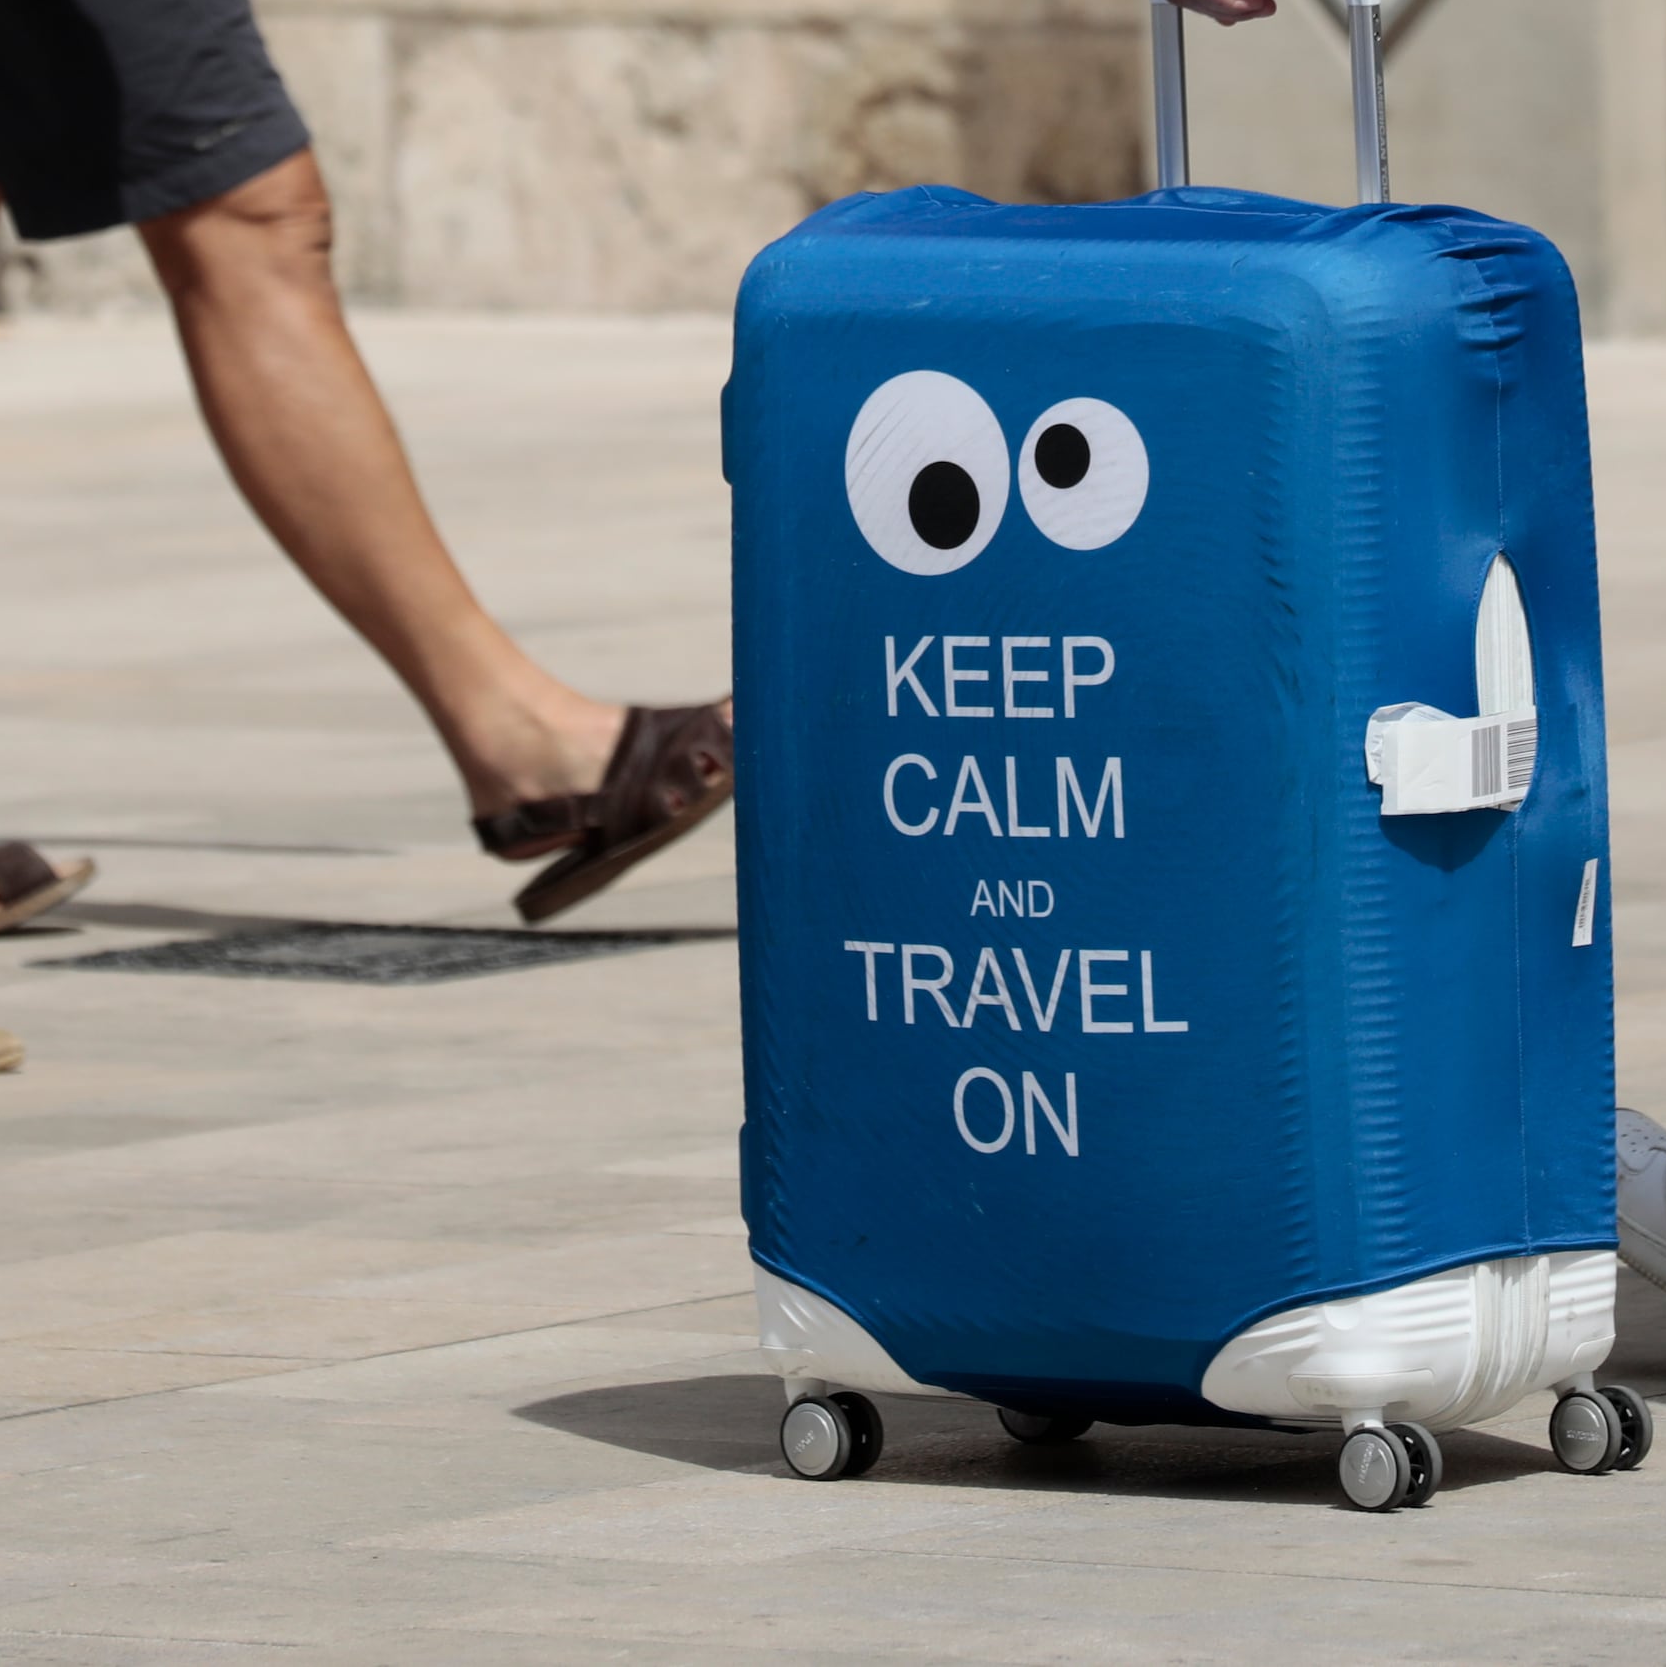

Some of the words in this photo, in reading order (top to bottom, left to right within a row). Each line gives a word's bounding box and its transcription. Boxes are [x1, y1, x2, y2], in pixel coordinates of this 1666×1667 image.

[1376, 74, 1388, 160] AMERICAN
[885, 635, 1115, 719] KEEP
[883, 753, 1125, 839] CALM
[970, 879, 1054, 918] AND
[844, 940, 1189, 1033] TRAVEL
[953, 1067, 1079, 1157] ON
